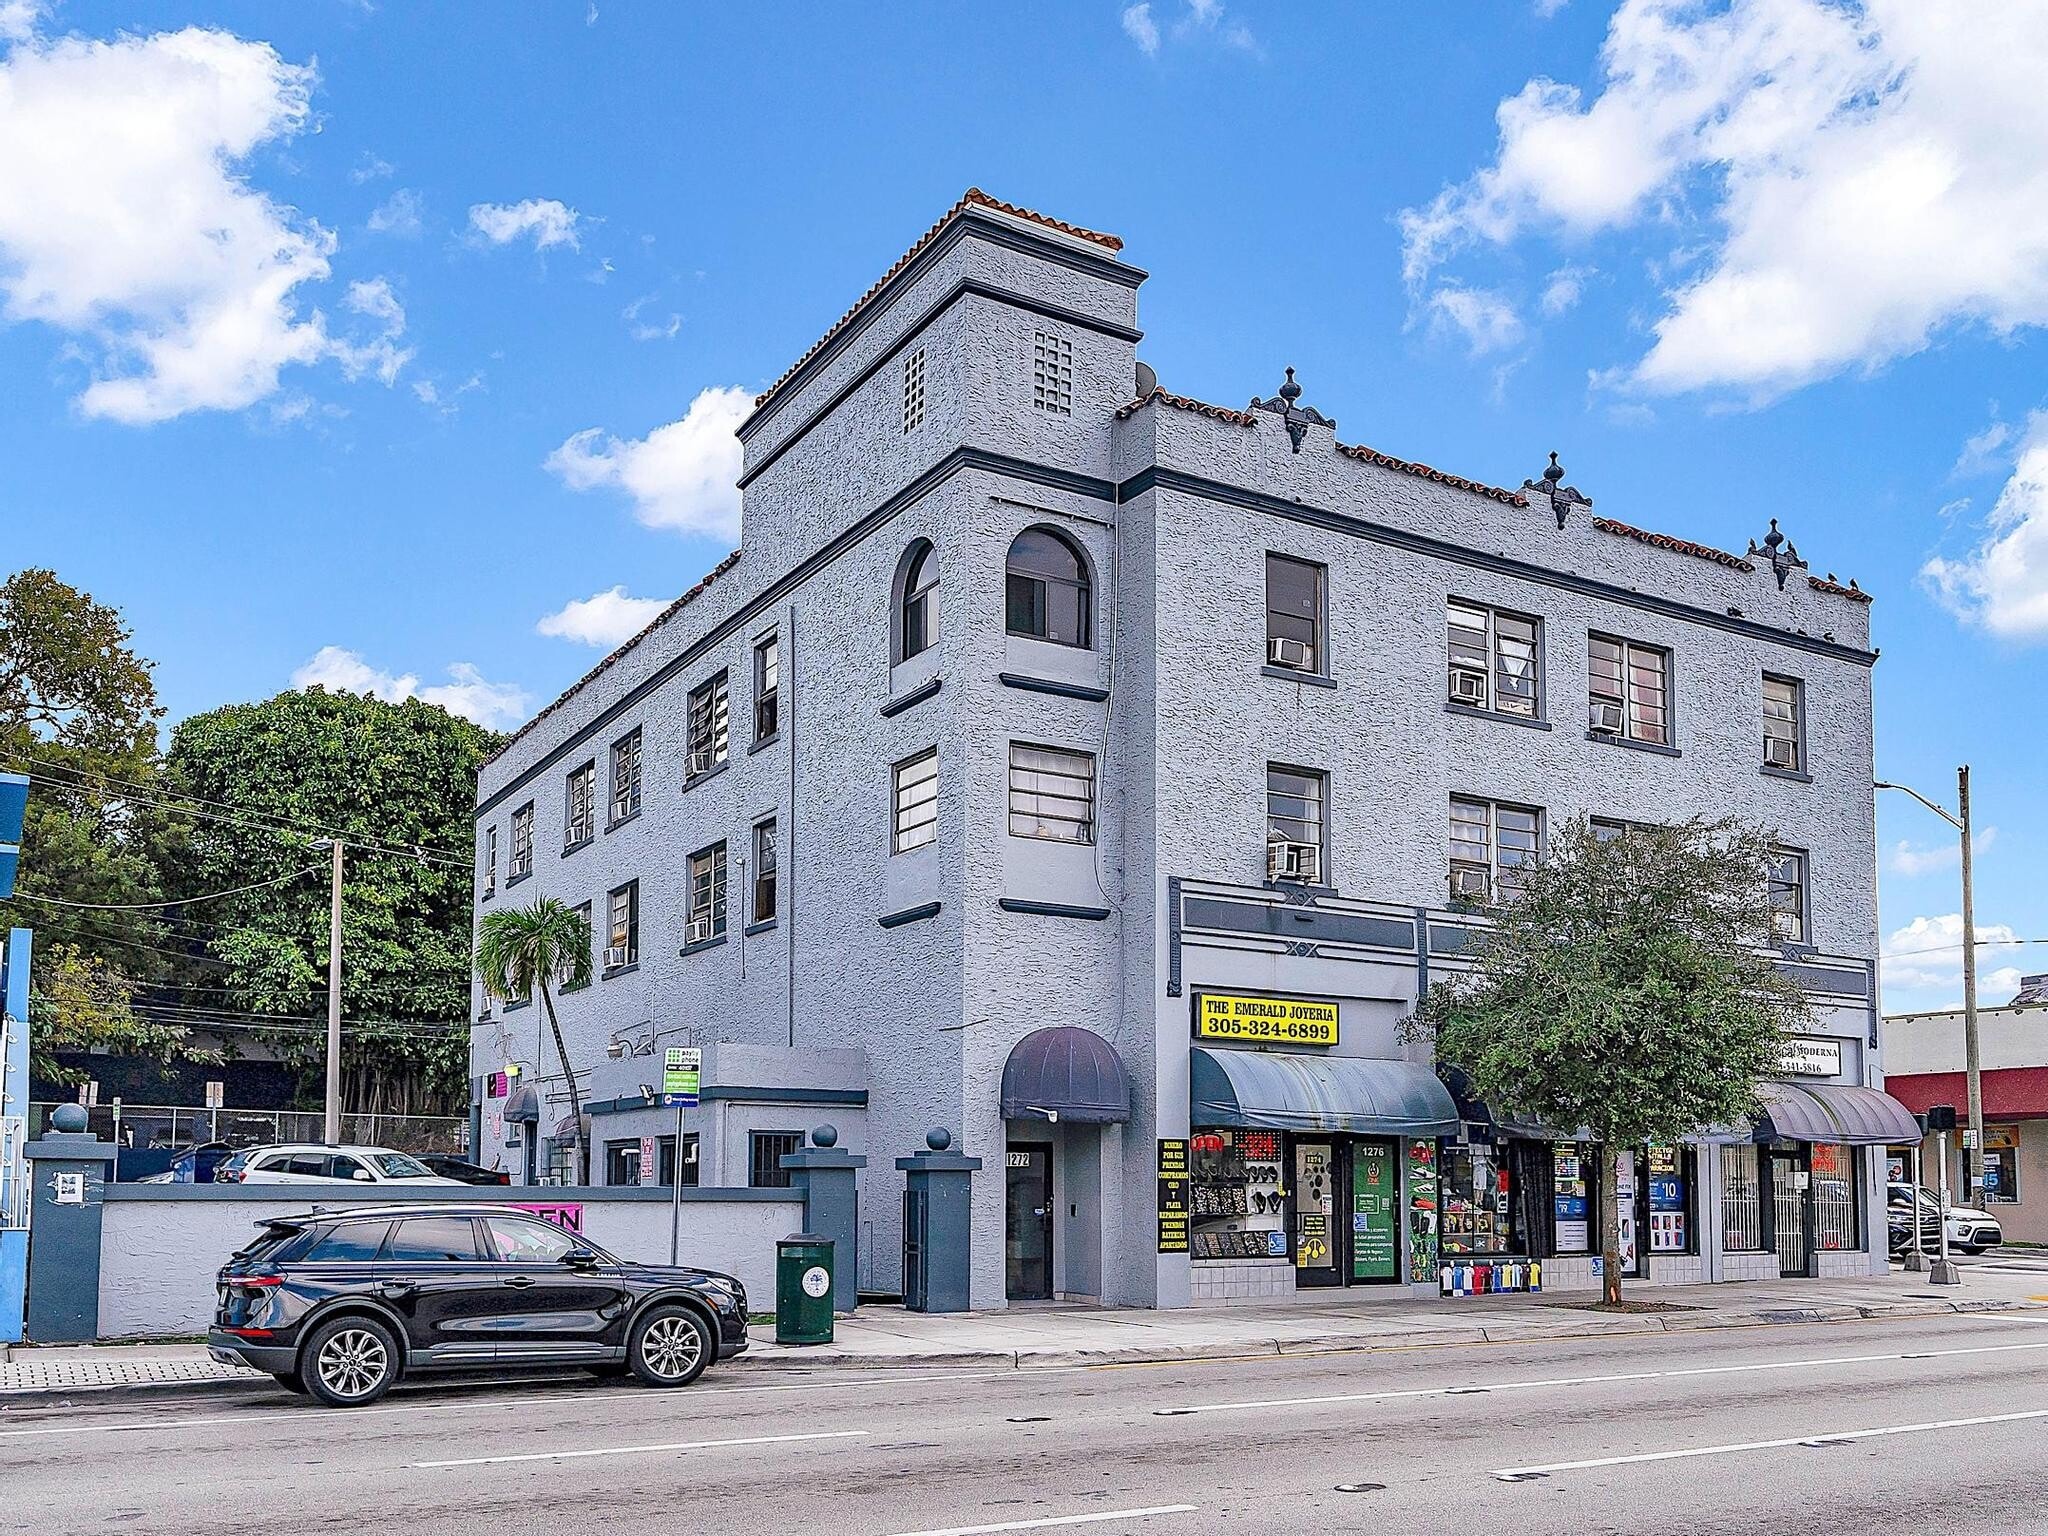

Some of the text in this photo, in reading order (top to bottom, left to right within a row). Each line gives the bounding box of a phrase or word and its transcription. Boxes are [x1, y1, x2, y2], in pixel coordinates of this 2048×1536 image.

[1206, 1000, 1334, 1021] THE EMERALD JOYERIA
[1208, 1018, 1329, 1039] 305-324-6899
[1191, 1135, 1224, 1152] OPEN
[1362, 1147, 1385, 1157] 1276
[1006, 1153, 1029, 1166] 1272
